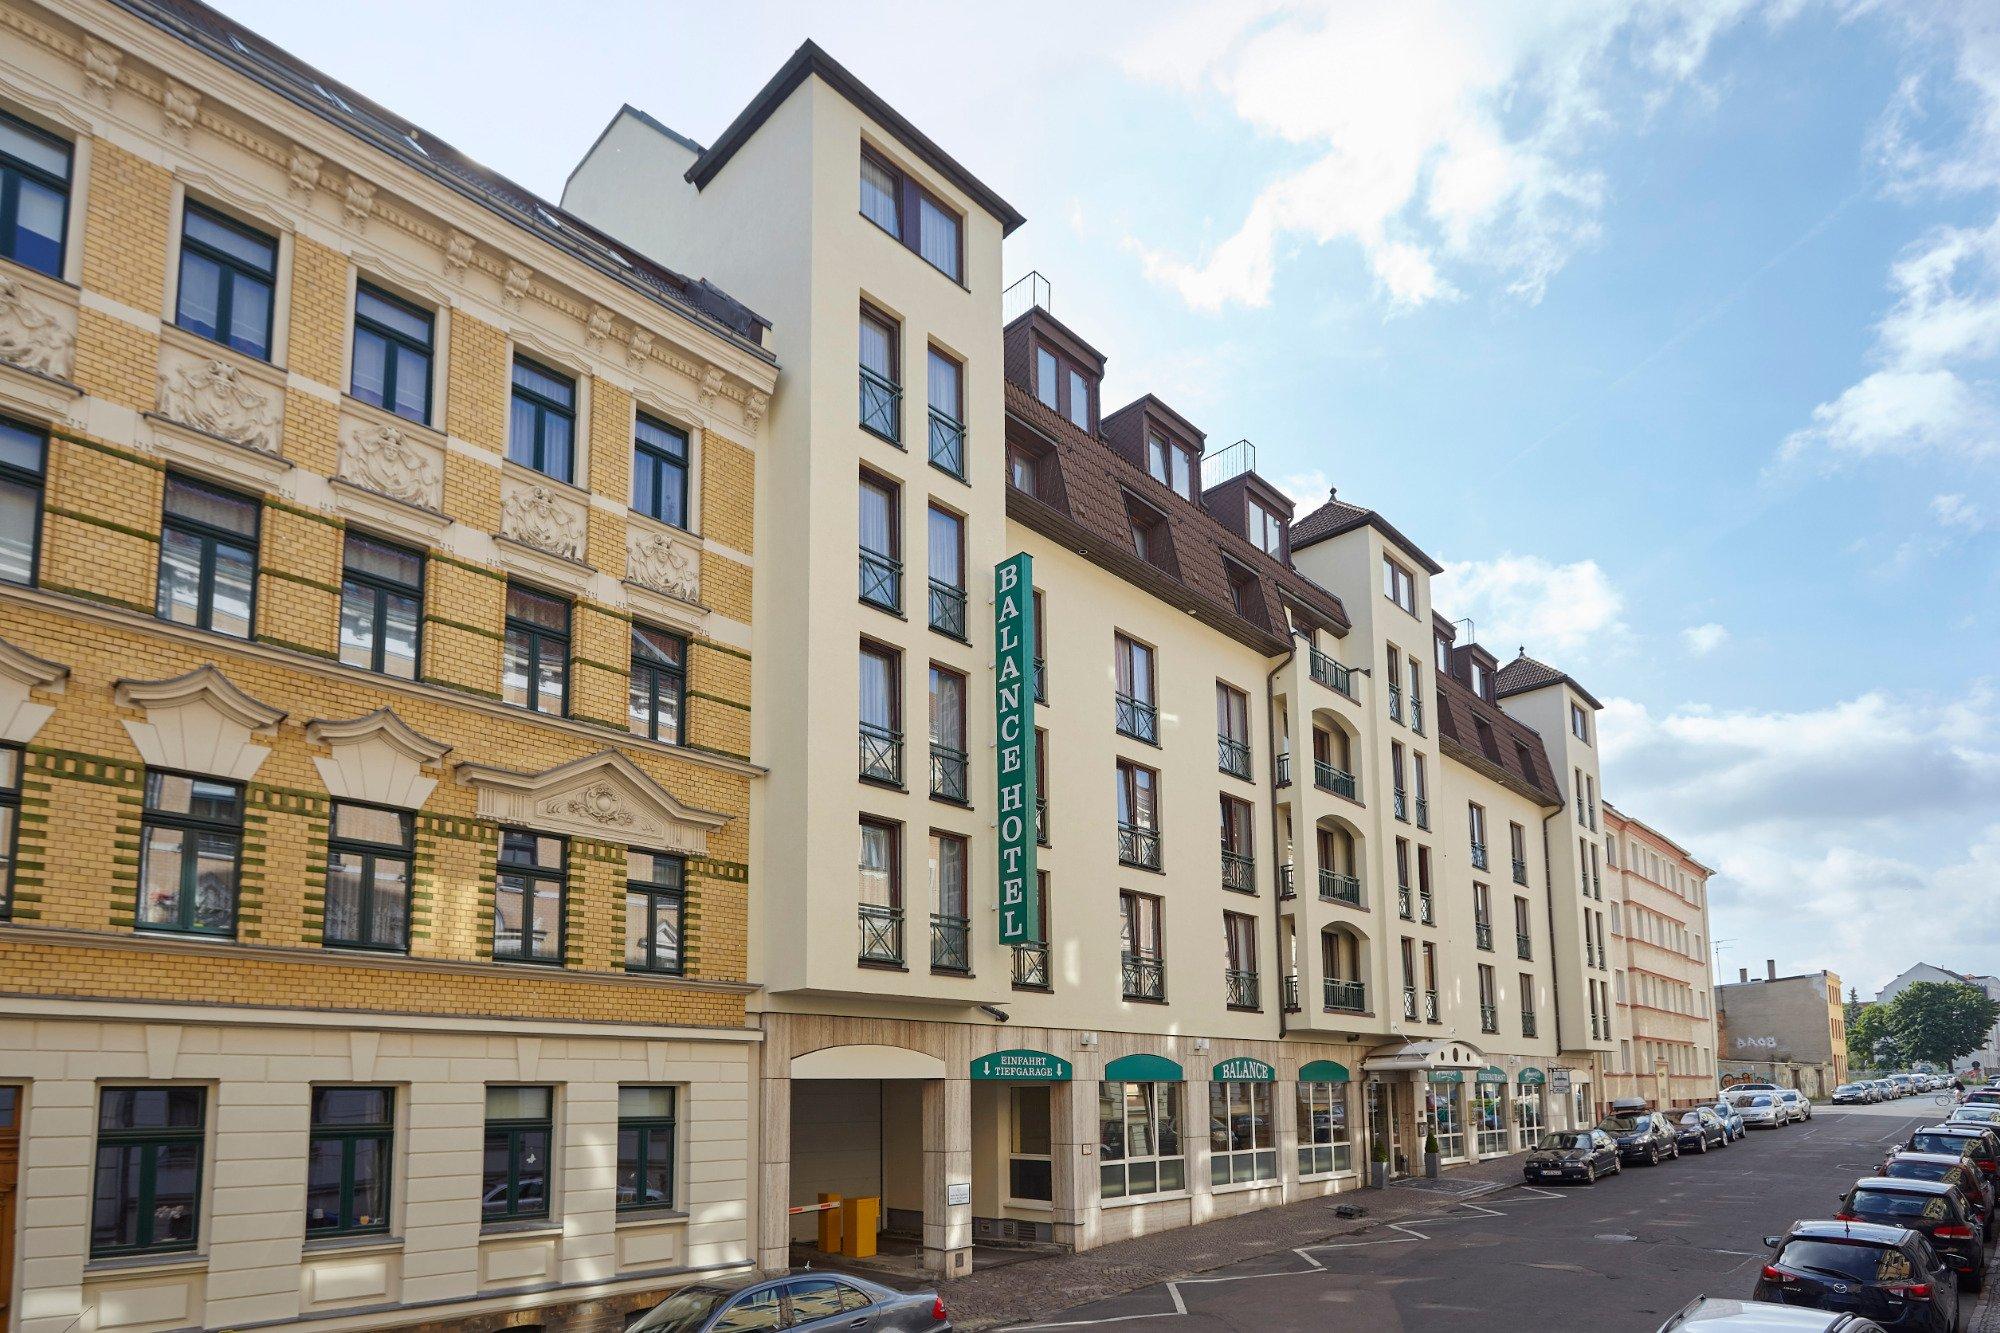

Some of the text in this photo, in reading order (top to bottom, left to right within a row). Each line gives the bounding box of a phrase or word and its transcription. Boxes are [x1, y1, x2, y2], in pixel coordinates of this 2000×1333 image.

[998, 564, 1023, 937] BALANCE HOTEL
[1001, 1056, 1046, 1066] EINFAHRT
[995, 1067, 1053, 1077] TIEFGARAGE
[1222, 1061, 1268, 1079] BALANCE
